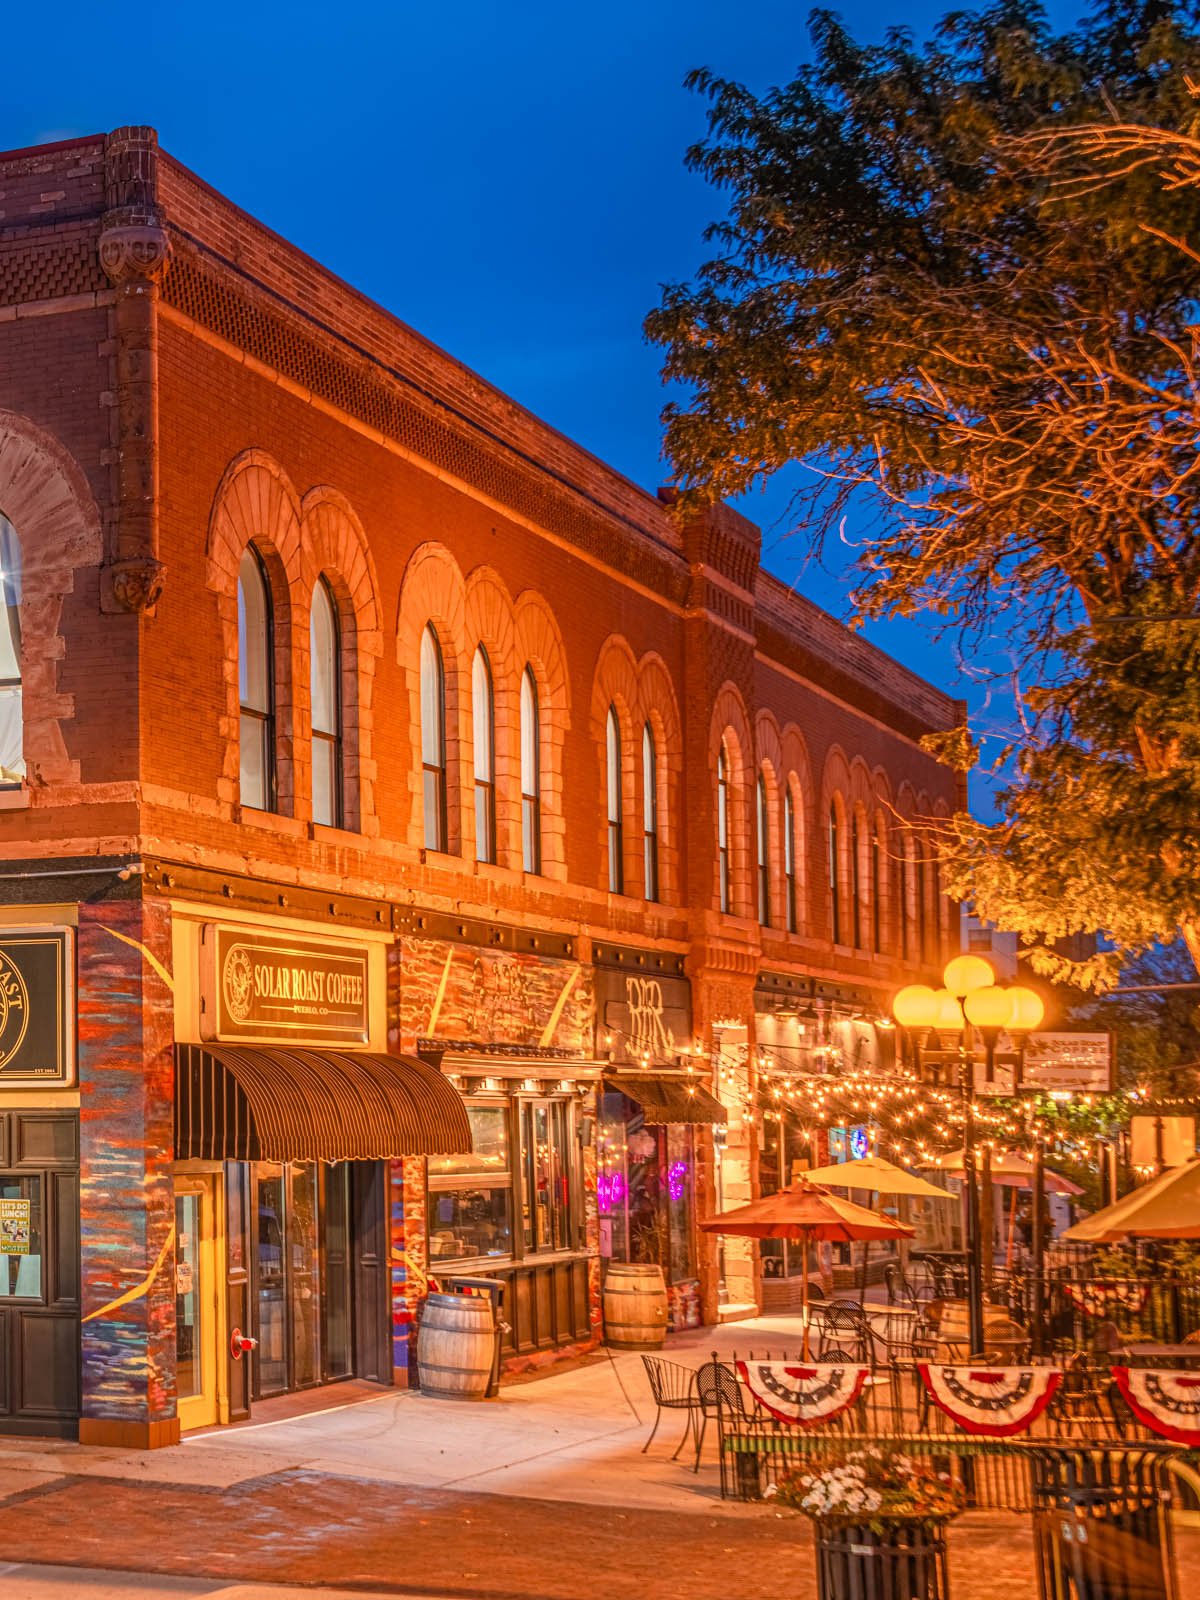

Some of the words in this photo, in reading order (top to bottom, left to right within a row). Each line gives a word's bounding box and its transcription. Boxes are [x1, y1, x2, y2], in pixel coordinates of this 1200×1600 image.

[254, 964, 291, 1000] SOLAR
[292, 968, 325, 1002] ROAST
[326, 972, 363, 1005] COFFEE
[1, 1210, 28, 1218] LUNCH!
